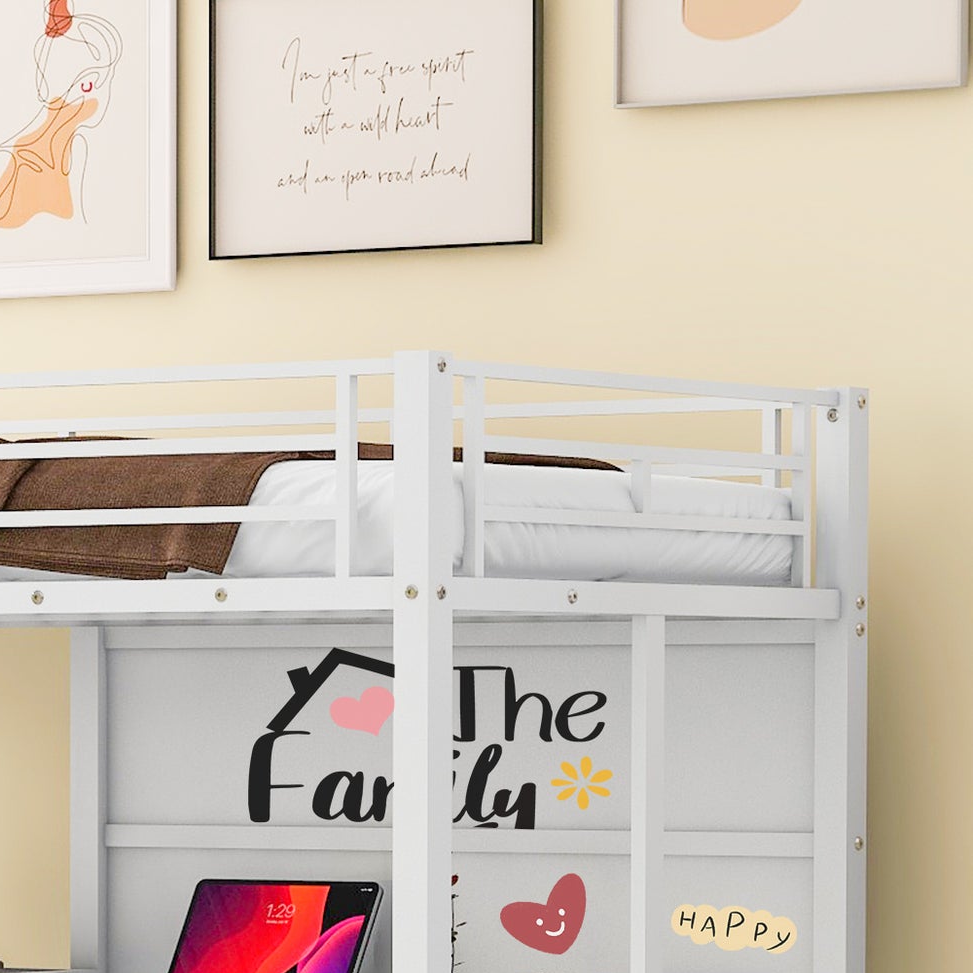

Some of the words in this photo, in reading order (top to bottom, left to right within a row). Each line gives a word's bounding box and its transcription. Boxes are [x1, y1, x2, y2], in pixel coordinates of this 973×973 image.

[322, 52, 373, 105] just
[377, 61, 415, 94] free
[421, 49, 474, 91] spirit
[304, 107, 336, 144] with
[360, 104, 390, 141] wild
[395, 96, 454, 133] heart
[277, 159, 309, 194] and
[314, 174, 335, 184] an
[341, 169, 372, 201] open
[377, 155, 418, 184] road
[420, 151, 471, 181] ahead
[453, 665, 608, 743] The
[266, 903, 296, 919] 1:29
